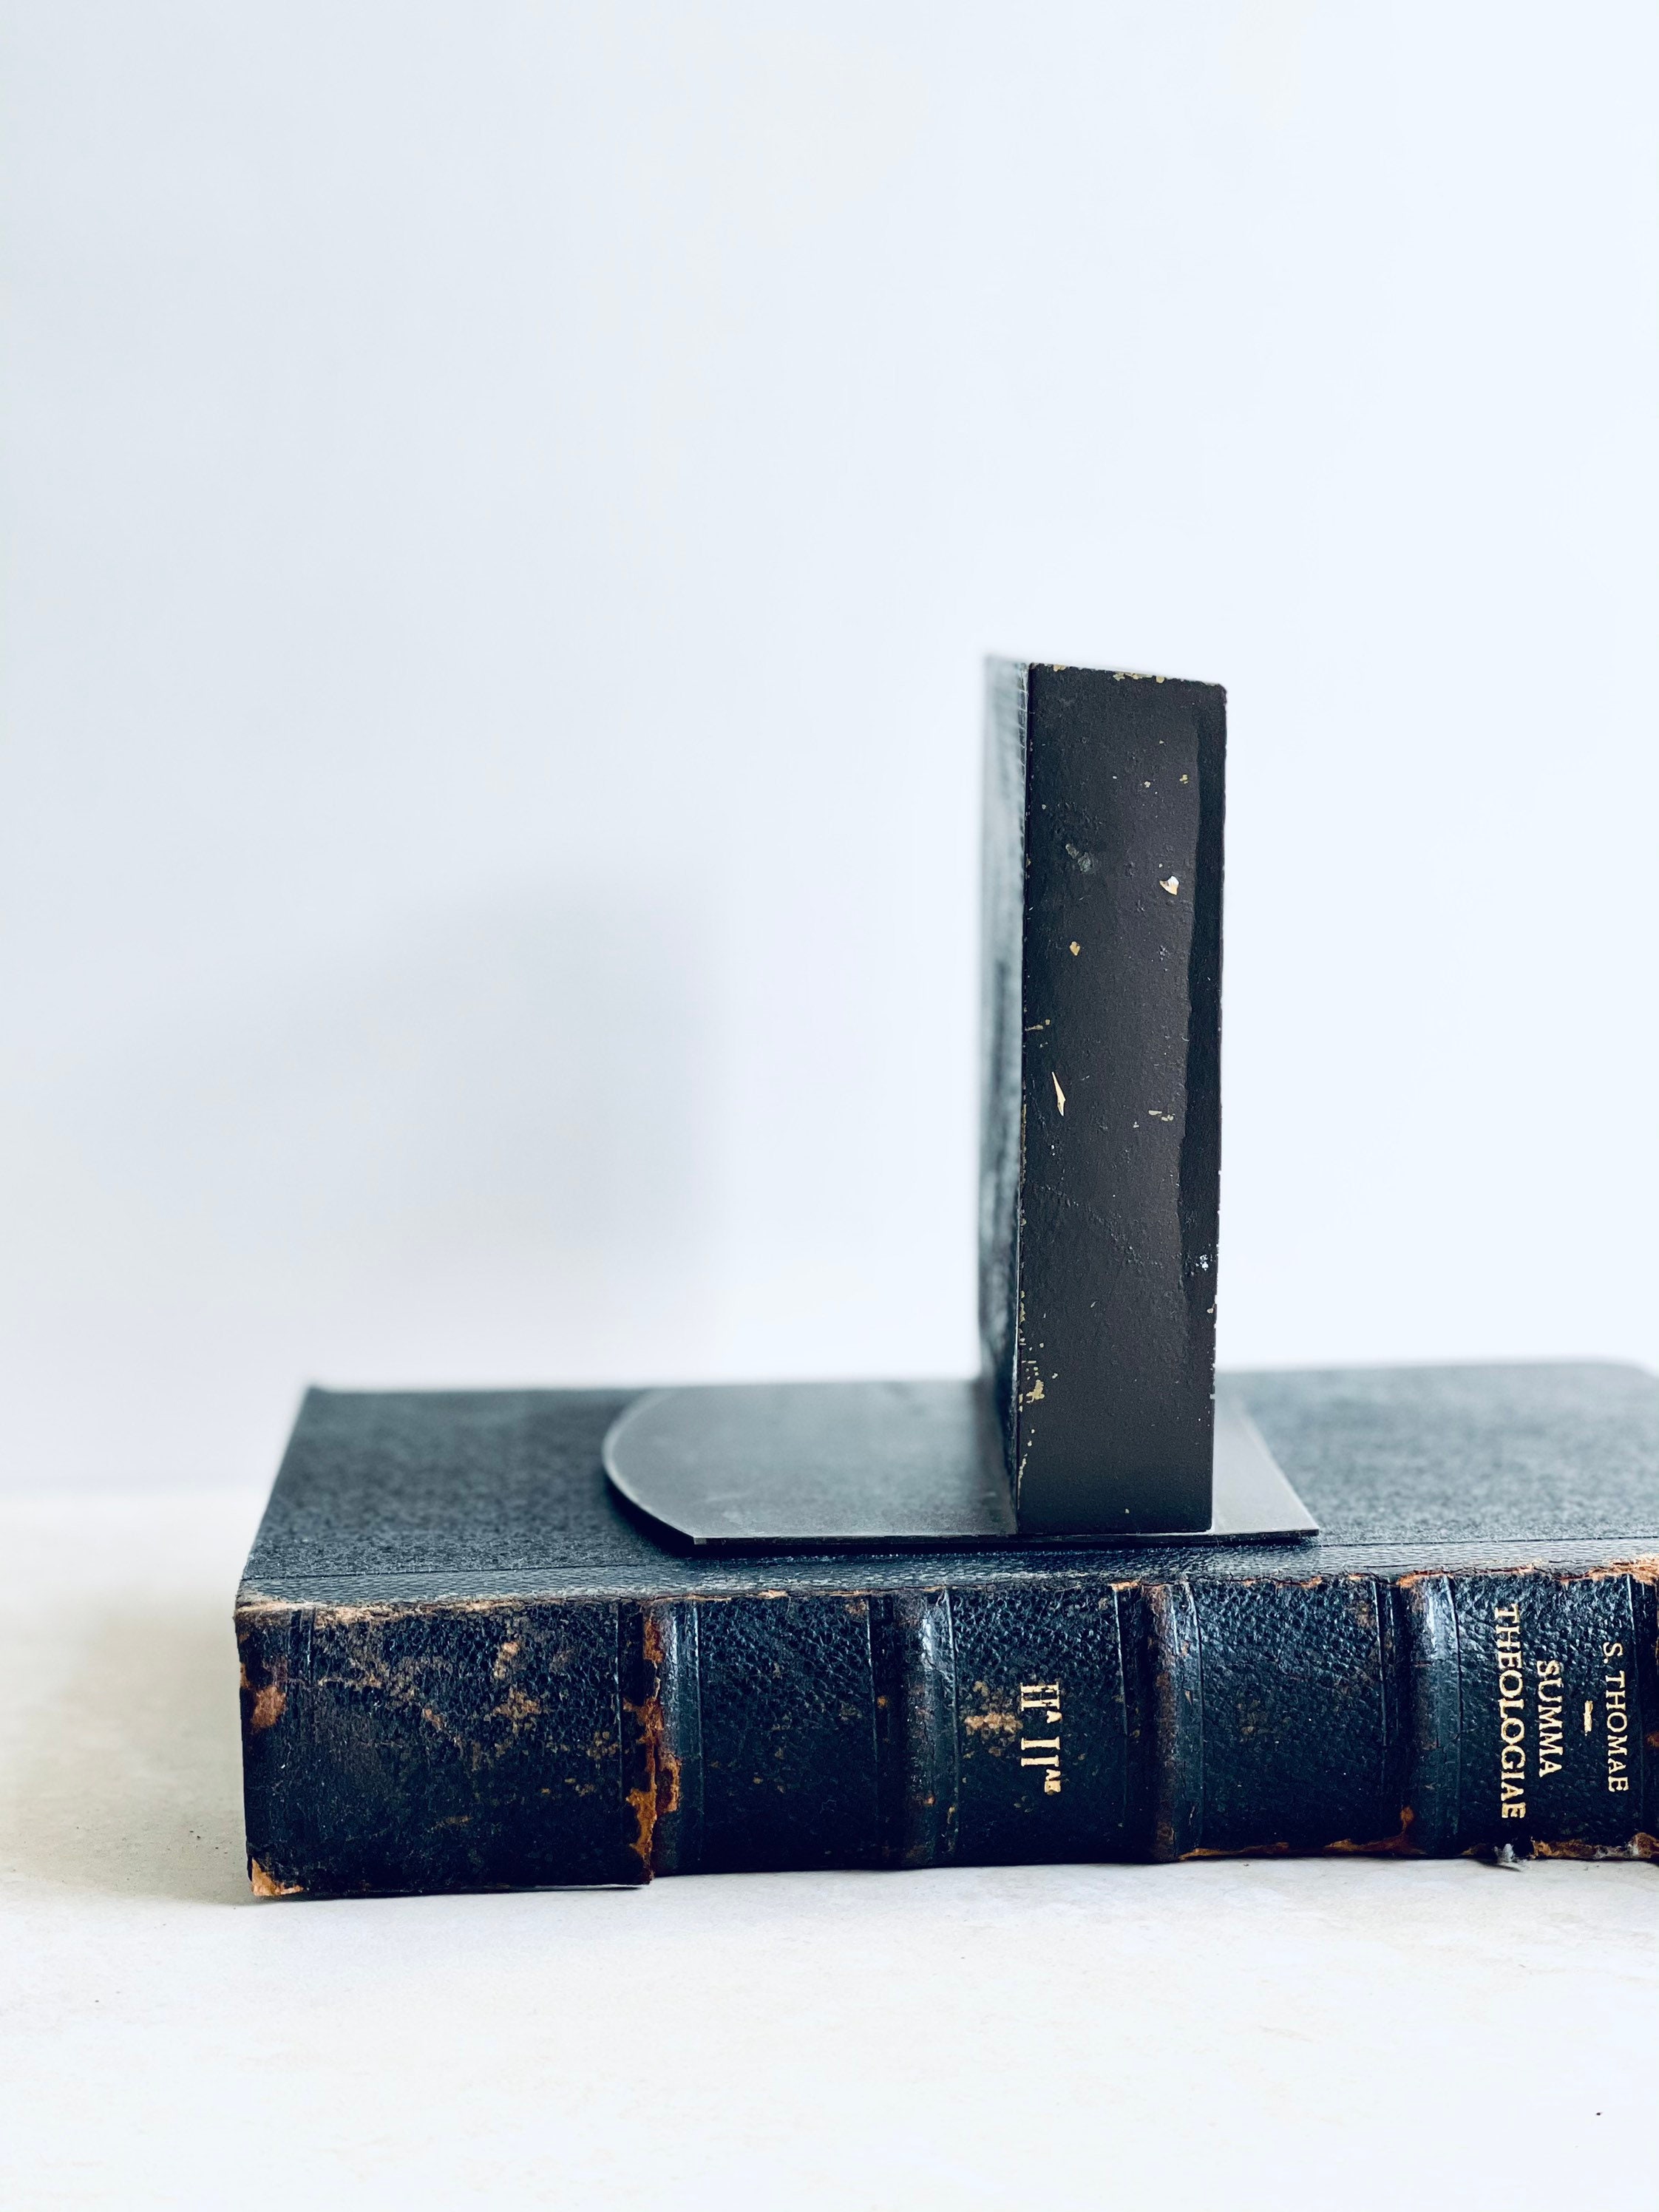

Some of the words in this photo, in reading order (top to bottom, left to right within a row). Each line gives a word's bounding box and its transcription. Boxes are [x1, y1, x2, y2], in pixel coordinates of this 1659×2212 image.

[1495, 1604, 1526, 1819] THEOLOGIAE
[1603, 1642, 1624, 1663] S.
[1536, 1660, 1564, 1777] SUMMA
[1605, 1672, 1629, 1792] THOMAE
